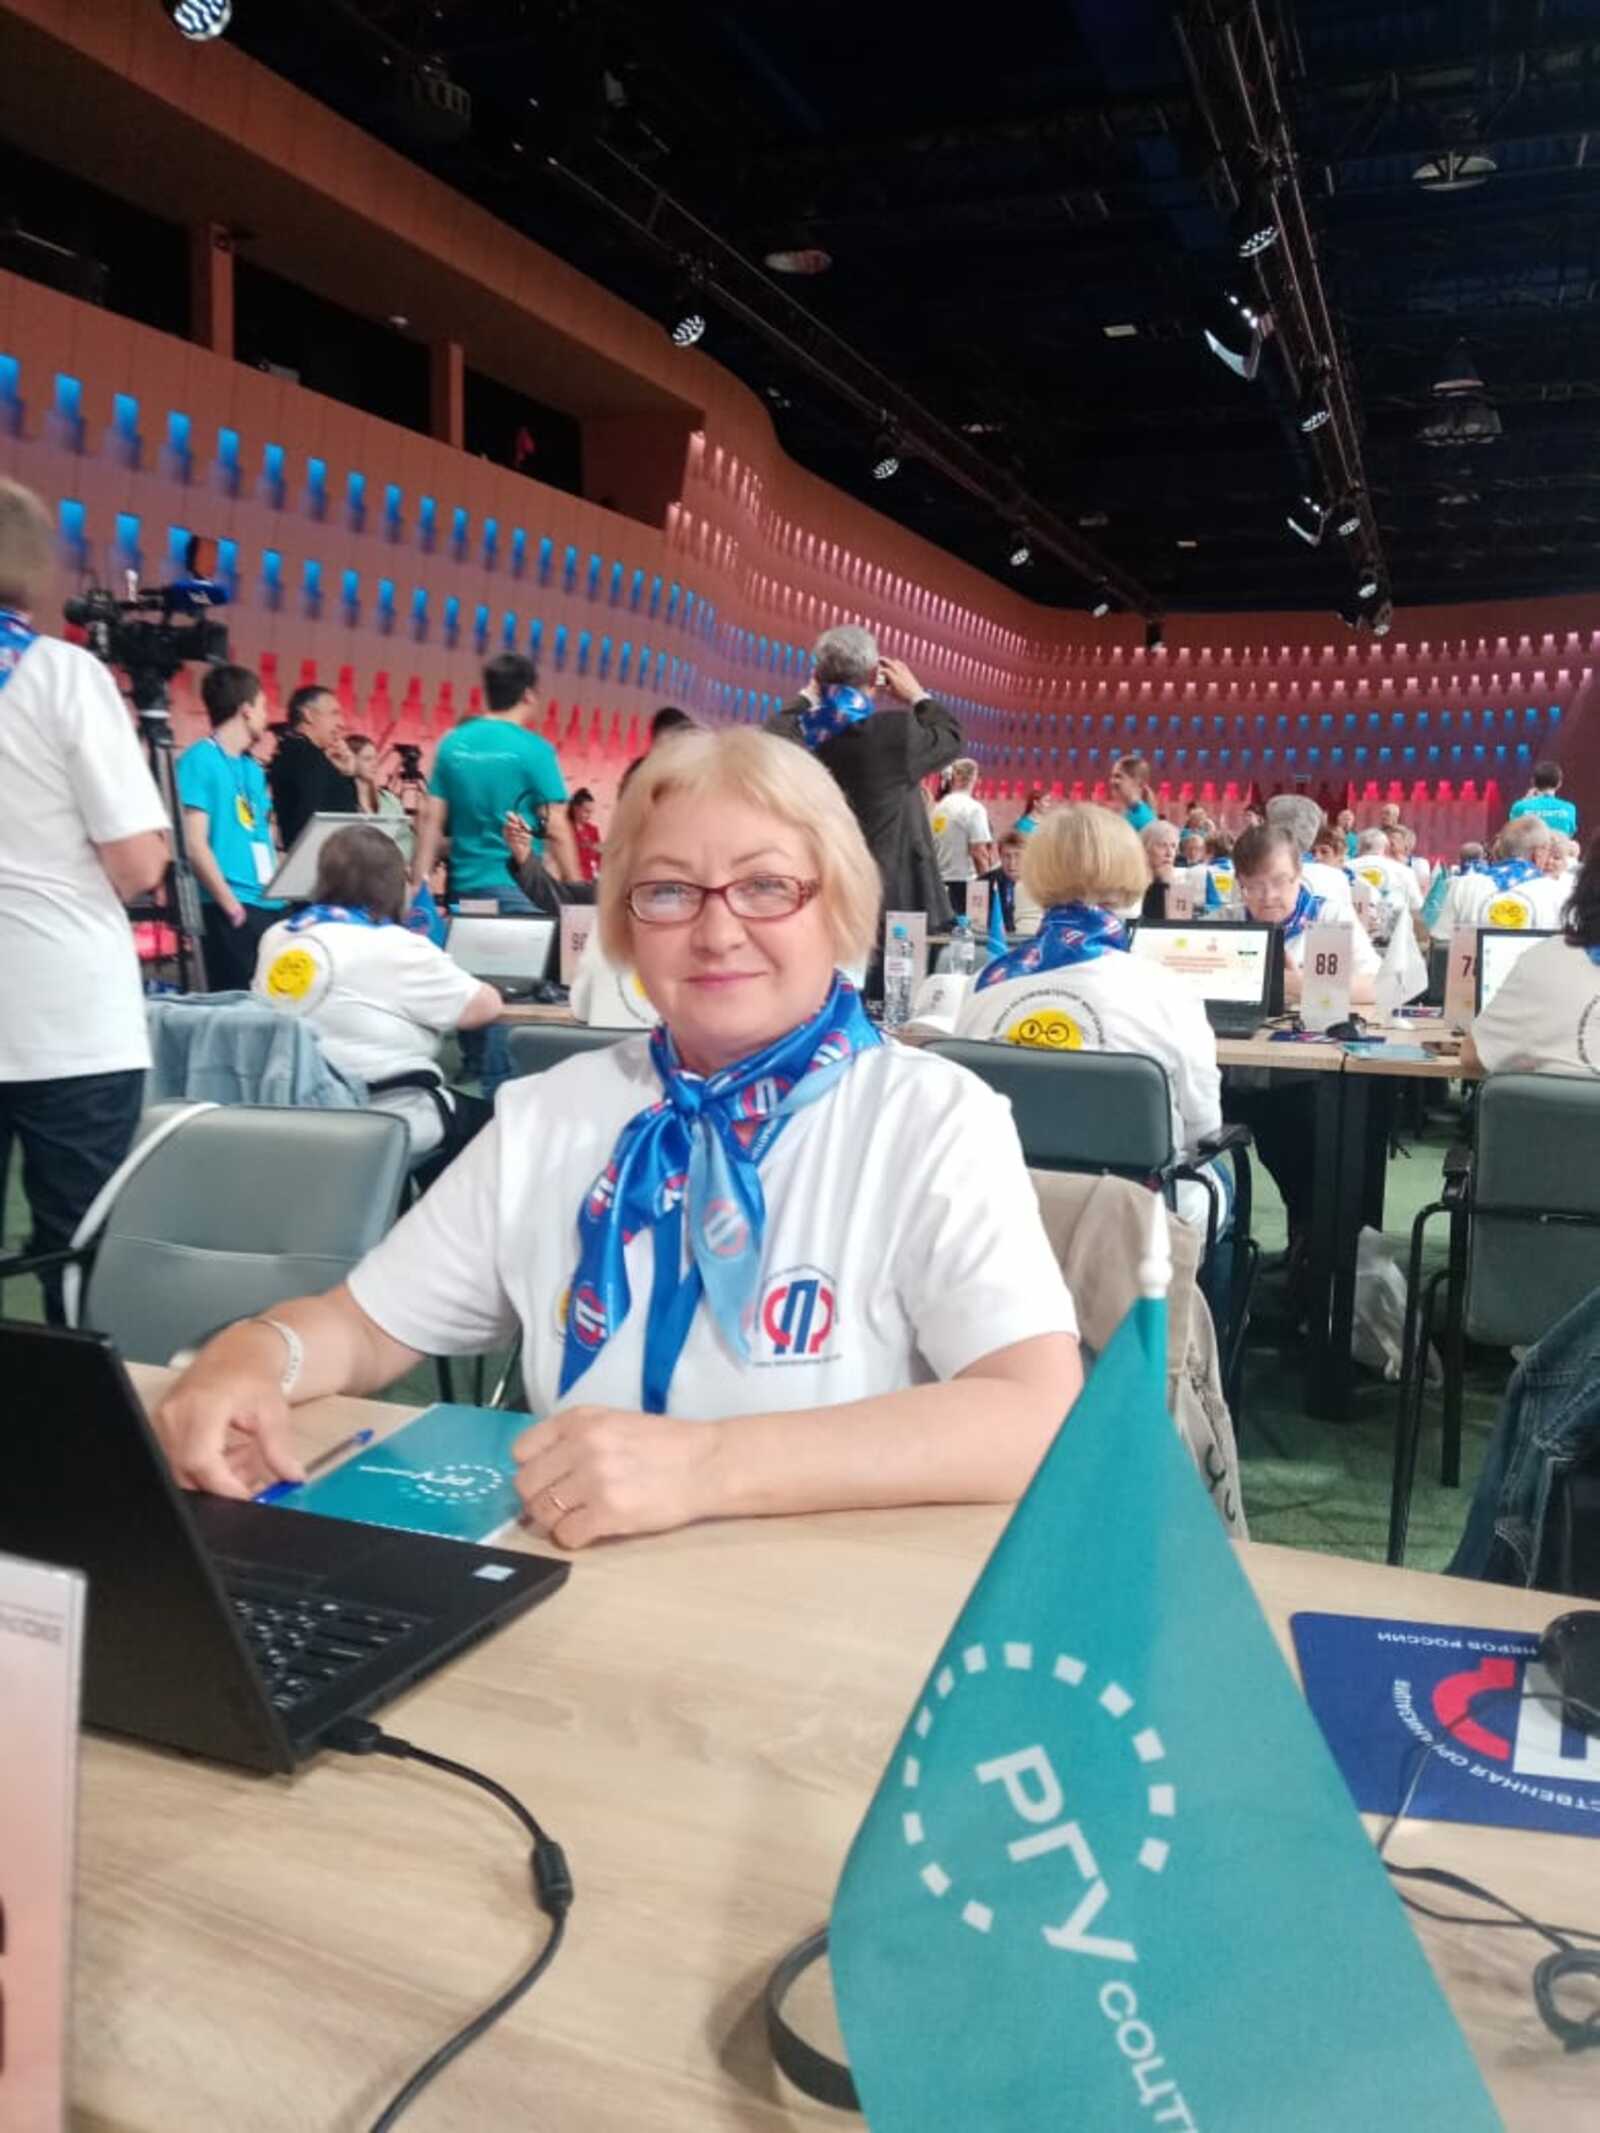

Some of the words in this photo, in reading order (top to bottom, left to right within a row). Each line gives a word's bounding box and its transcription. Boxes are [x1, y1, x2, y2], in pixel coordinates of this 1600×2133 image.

[1315, 952, 1338, 976] 88
[1466, 1639, 1538, 1656] НЕРОВ
[974, 1743, 1139, 1963] РГУ
[1099, 1979, 1199, 2133] СОЦТ
